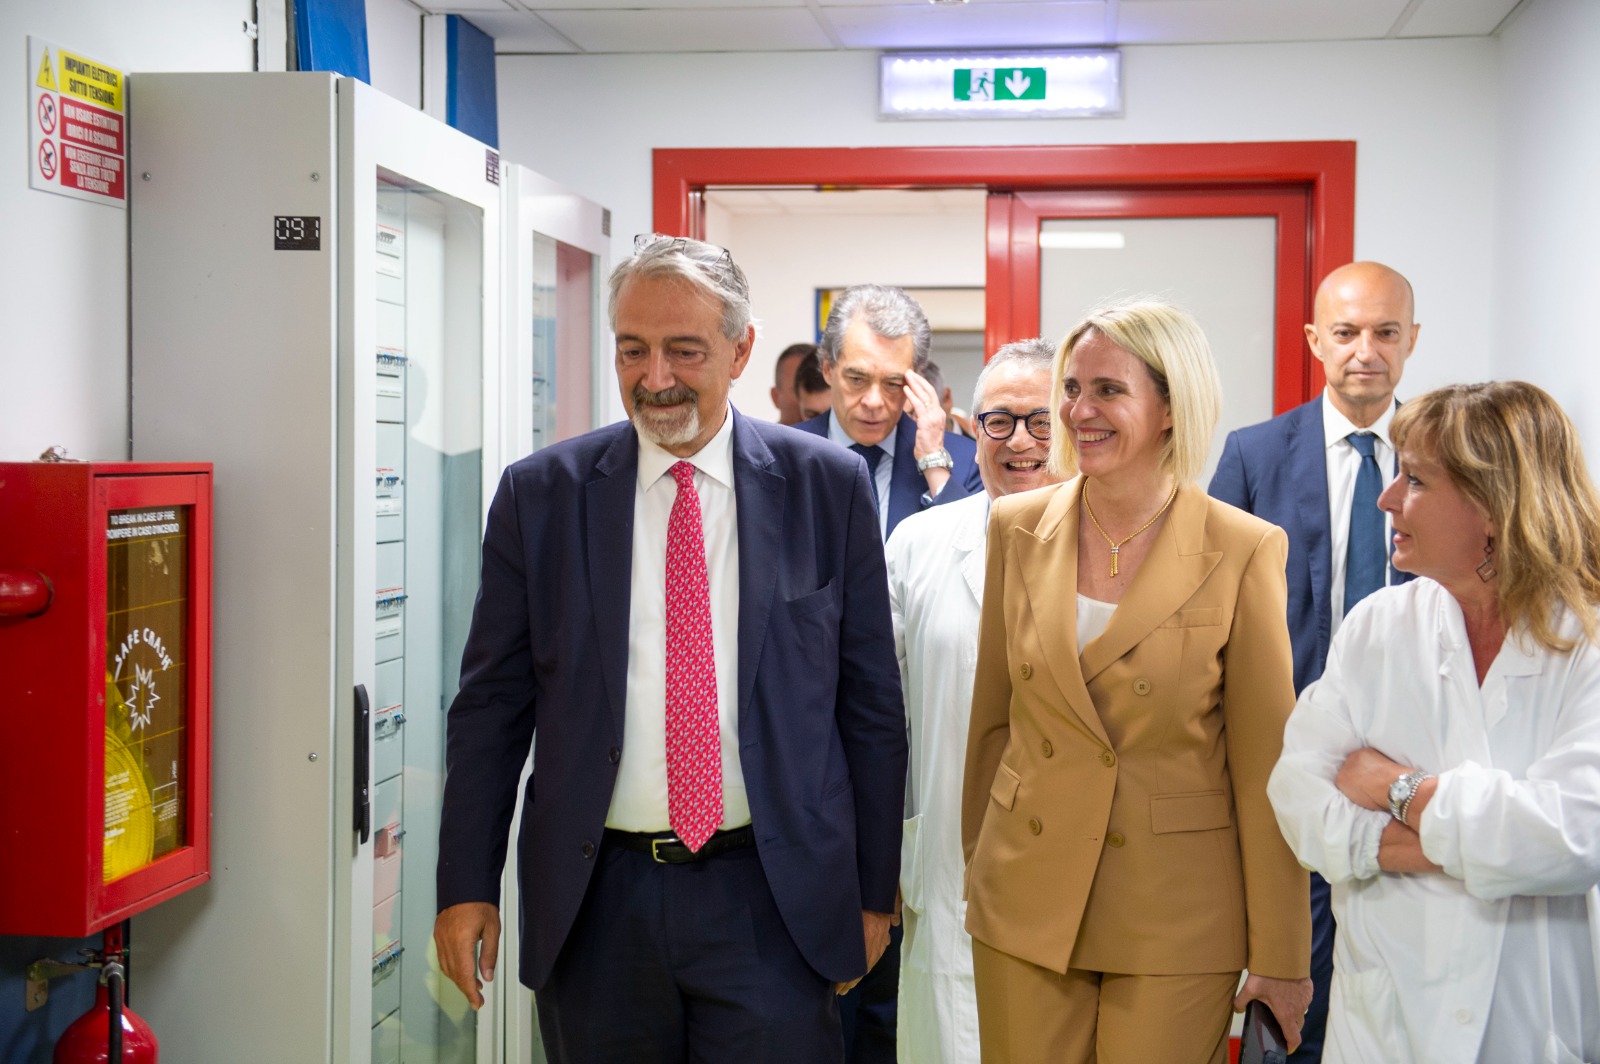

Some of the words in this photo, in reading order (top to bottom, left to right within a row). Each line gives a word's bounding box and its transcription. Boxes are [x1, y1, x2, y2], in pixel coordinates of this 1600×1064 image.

[64, 56, 90, 78] IMPIANTI
[92, 66, 117, 87] ELETTRICI
[69, 78, 87, 96] SOTTO
[89, 85, 115, 106] TENSIONE
[63, 103, 75, 120] NON
[75, 106, 93, 125] USARE
[64, 145, 77, 160] NON
[76, 174, 84, 188] LA
[85, 177, 109, 193] TENSIONE
[276, 217, 319, 240] 091
[110, 515, 118, 525] TO
[119, 514, 137, 524] BREAK
[143, 512, 157, 521] CASE
[157, 512, 164, 521] OF
[164, 510, 176, 520] FIRE
[115, 629, 140, 683] SAFE
